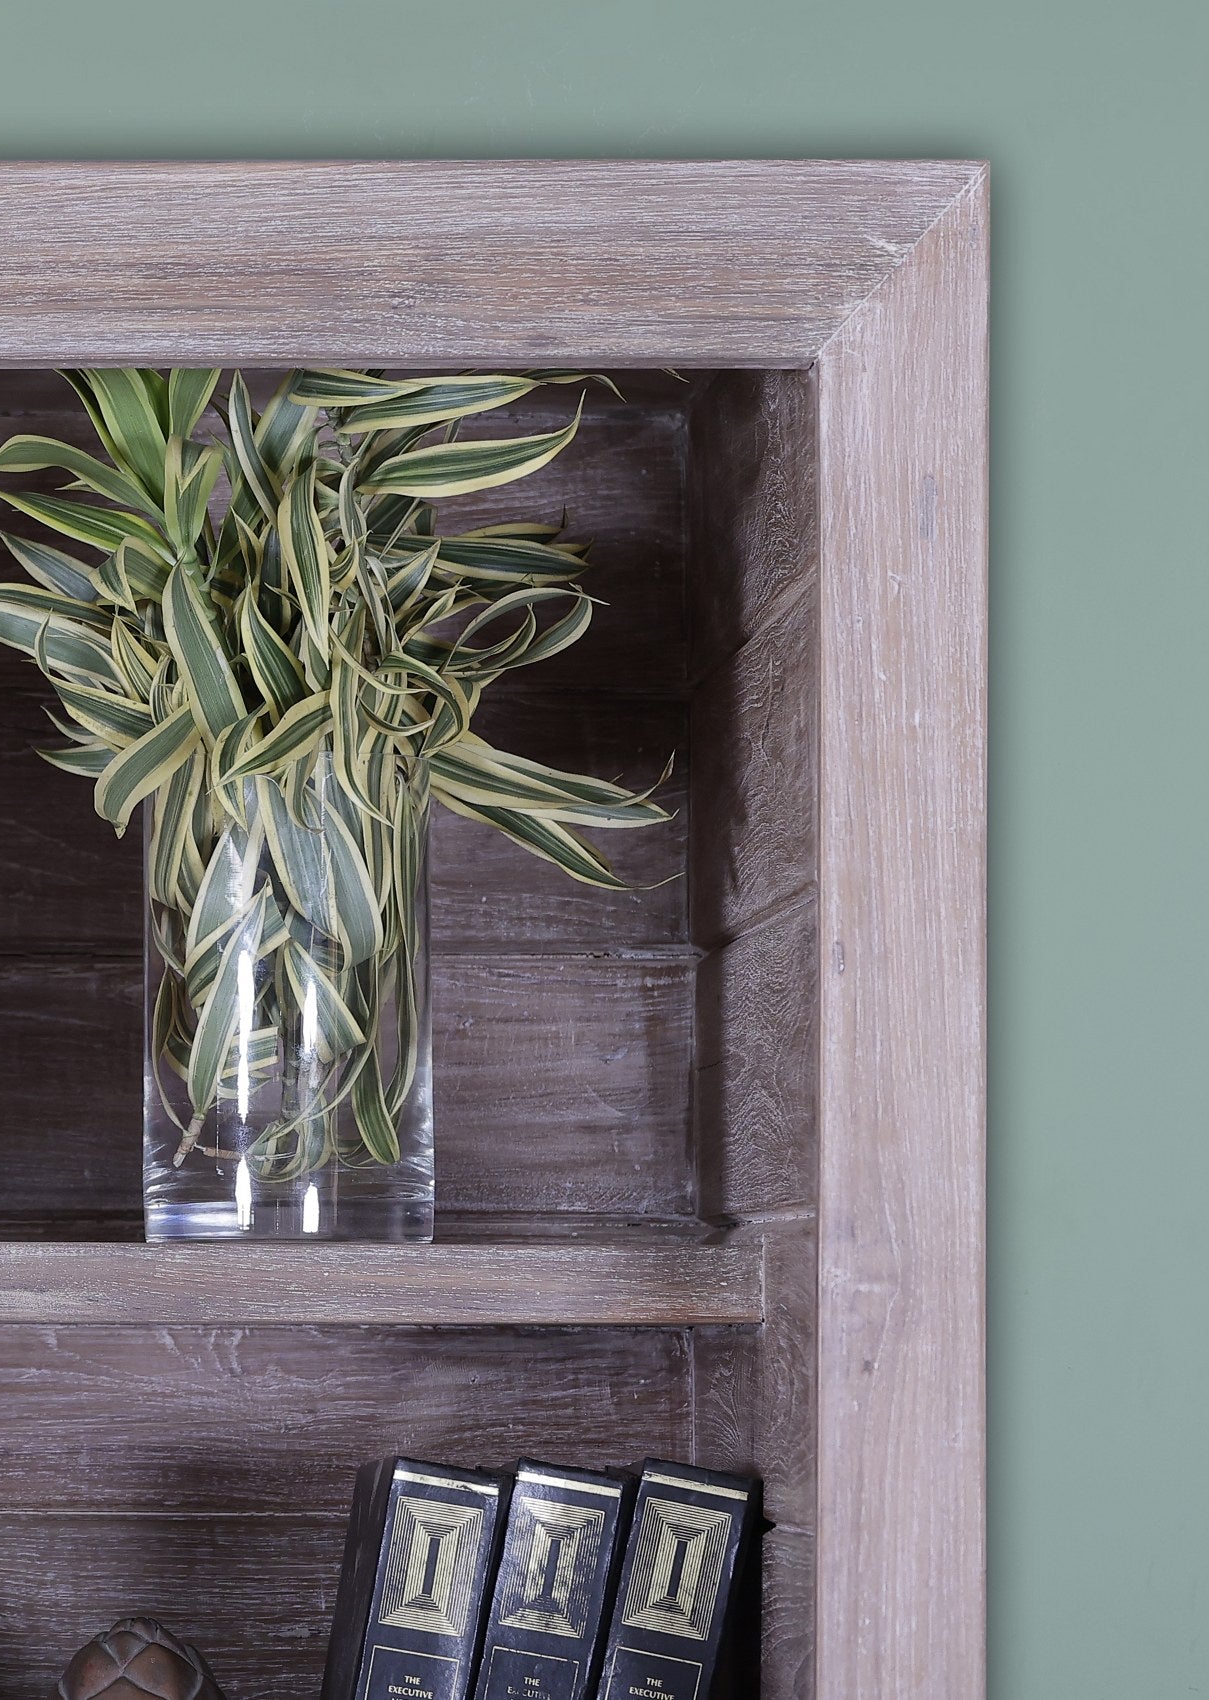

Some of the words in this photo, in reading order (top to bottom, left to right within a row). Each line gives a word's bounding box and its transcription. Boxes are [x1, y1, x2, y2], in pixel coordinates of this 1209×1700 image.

[404, 1675, 421, 1685] THE
[523, 1676, 541, 1687] THE
[646, 1677, 663, 1688] THE
[388, 1685, 434, 1700] EXECUTIVE
[629, 1686, 675, 1700] EXECUTIVE
